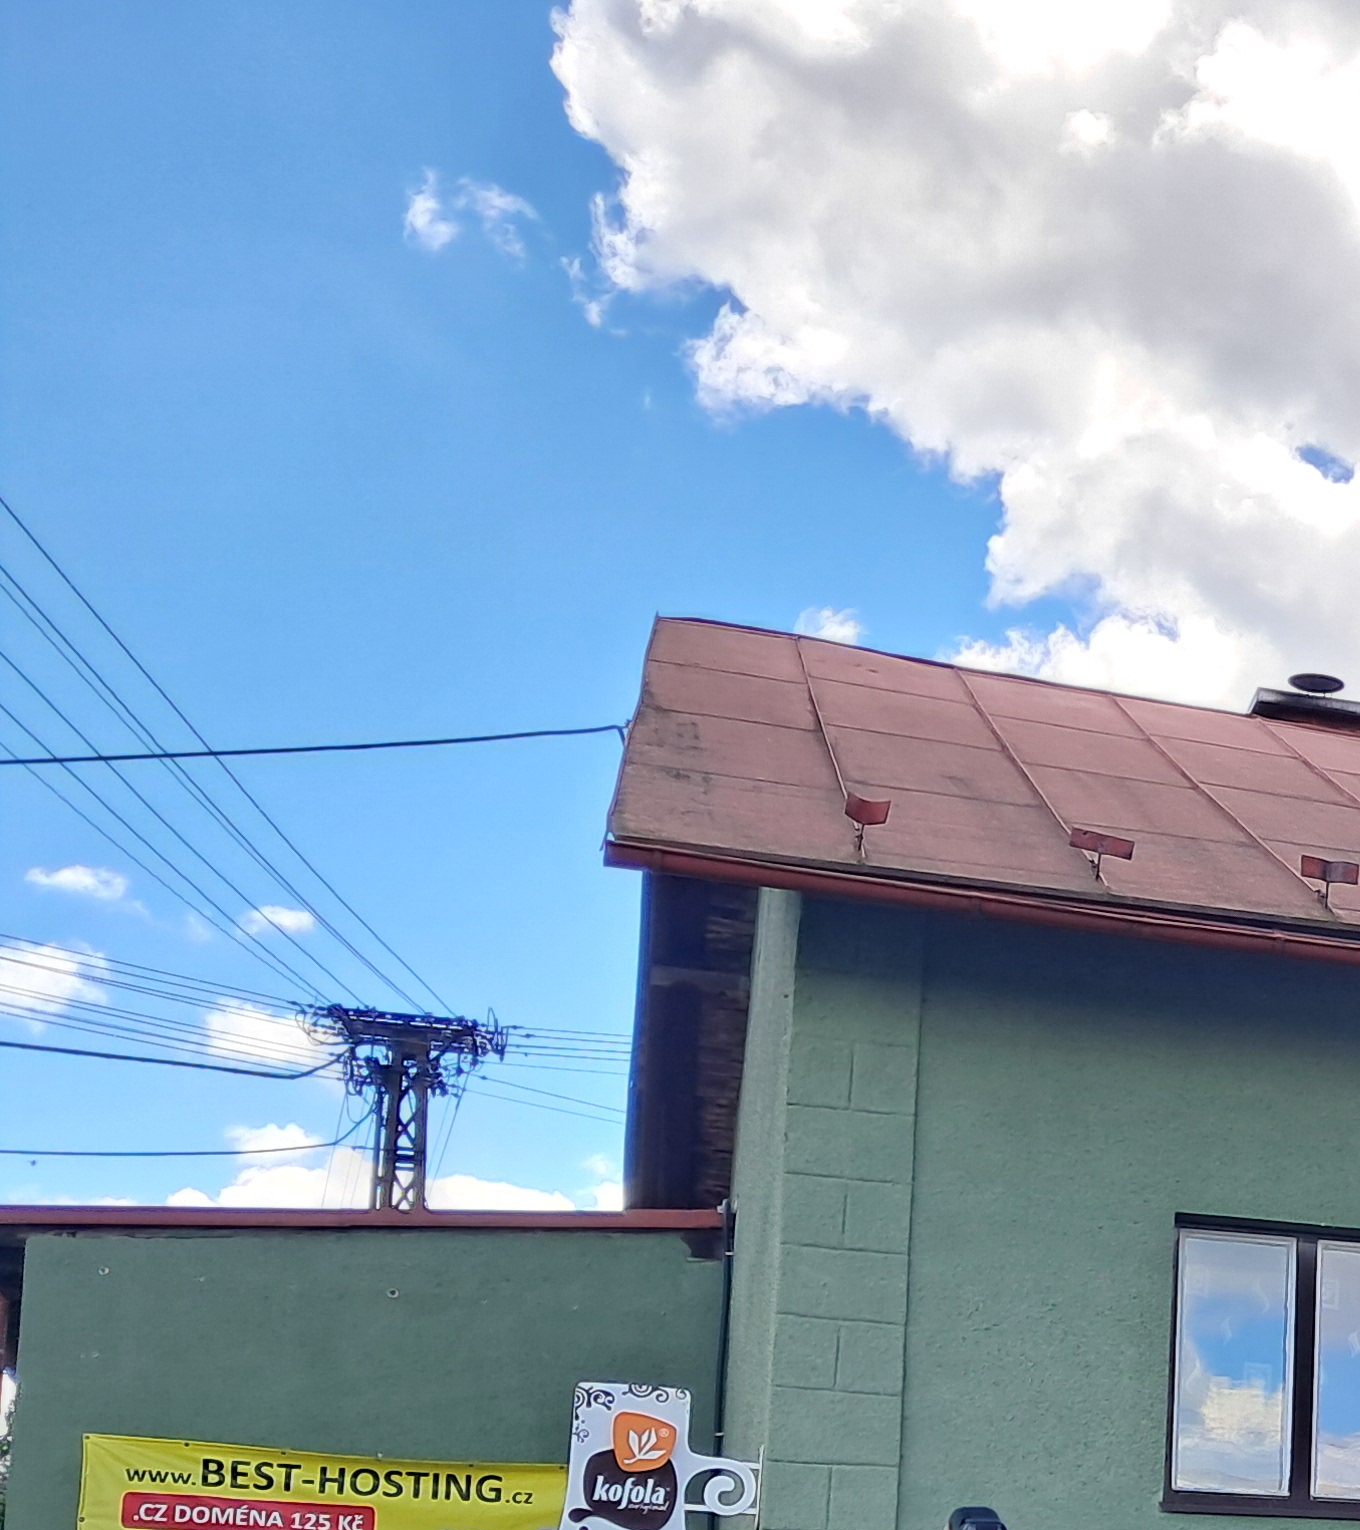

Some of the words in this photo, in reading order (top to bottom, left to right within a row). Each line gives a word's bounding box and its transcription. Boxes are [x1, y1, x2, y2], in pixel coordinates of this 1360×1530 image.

[125, 1457, 534, 1505] www.BEST-HOSTING.cz
[592, 1475, 666, 1510] kofola
[133, 1504, 168, 1523] .CZ
[174, 1503, 284, 1528] DOMÉNA
